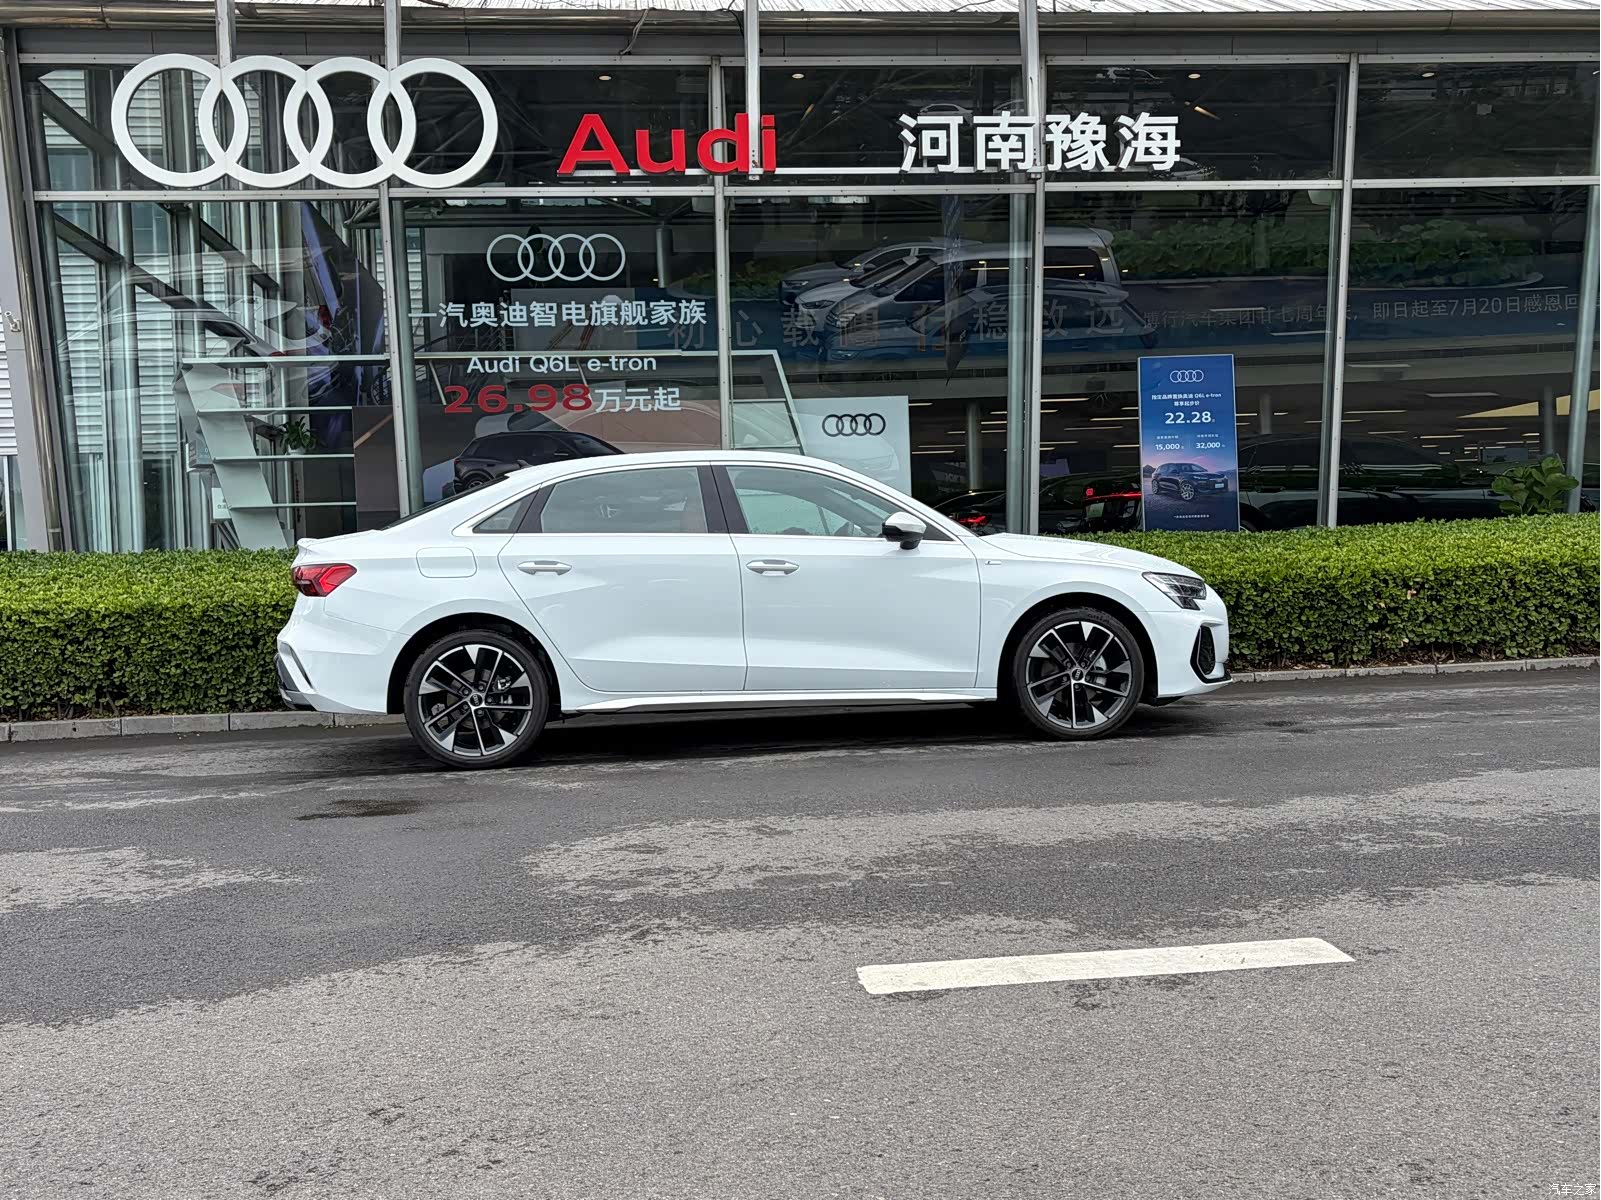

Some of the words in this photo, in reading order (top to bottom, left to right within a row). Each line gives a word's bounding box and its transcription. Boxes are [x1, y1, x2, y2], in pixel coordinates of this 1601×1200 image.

[556, 113, 777, 174] Audi
[898, 111, 1181, 172] 河南豫海
[408, 299, 707, 328] 一汽奥迪智电旗舰家族
[467, 356, 521, 373] Audi
[529, 356, 579, 373] Q6L
[587, 354, 657, 372] e-tron
